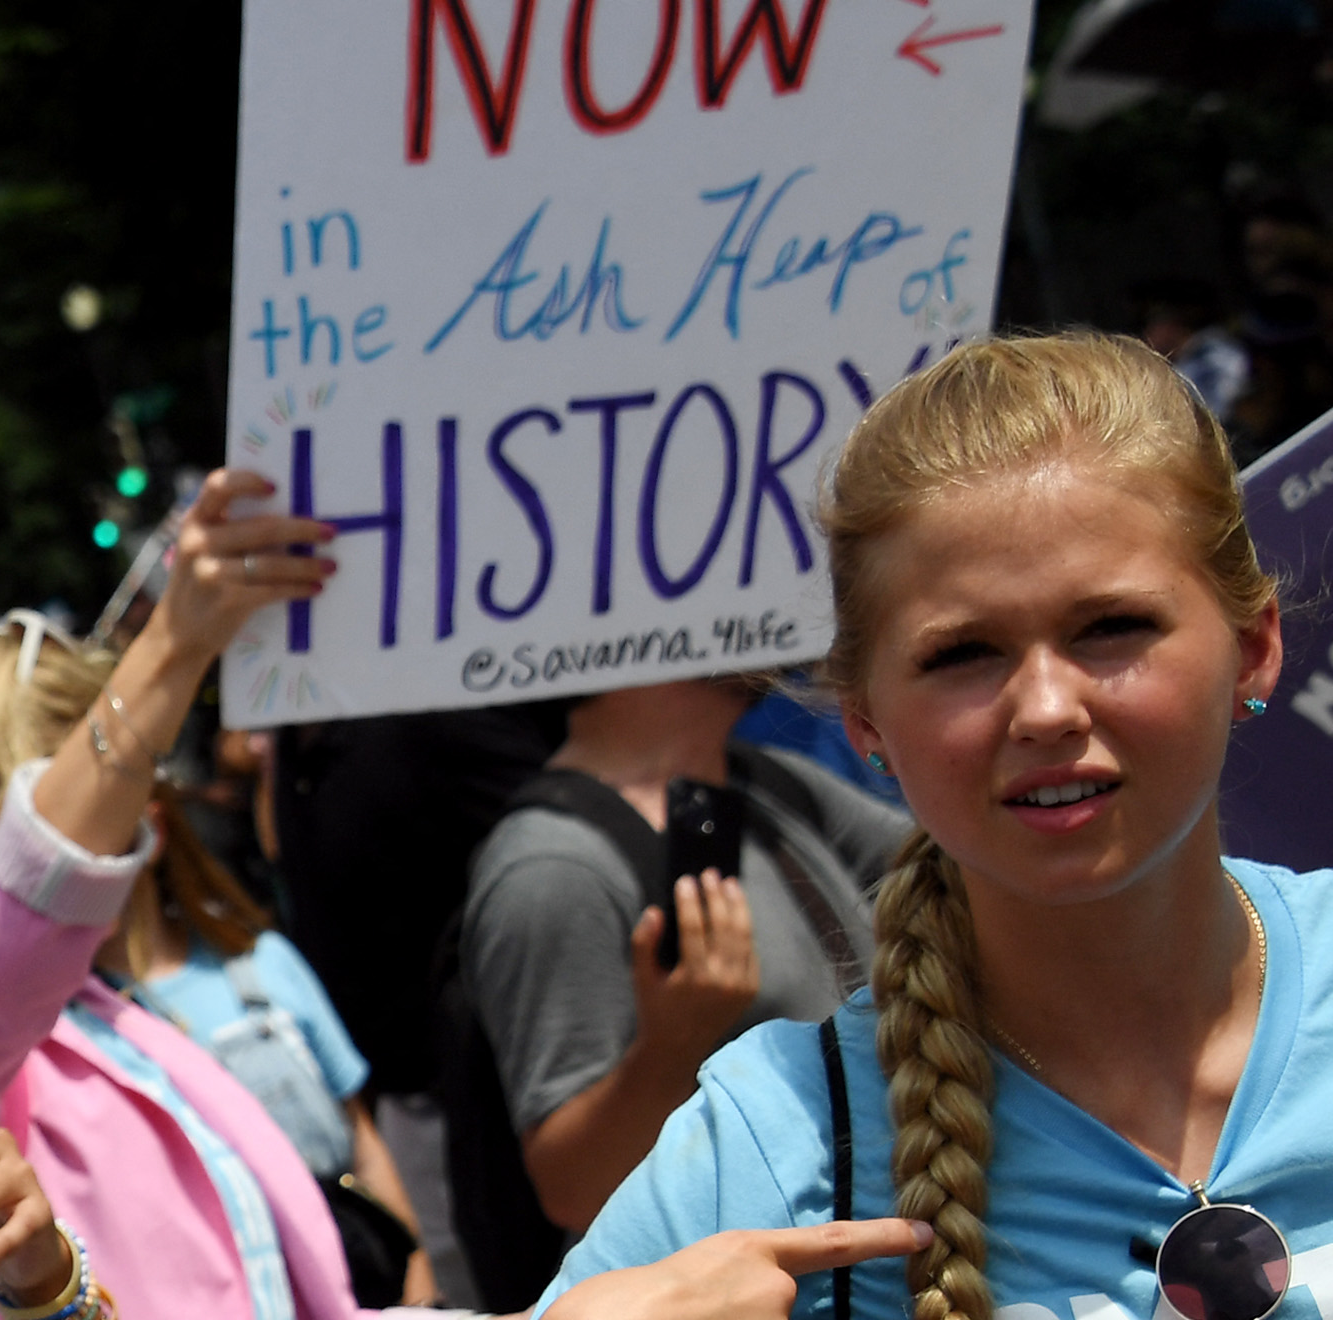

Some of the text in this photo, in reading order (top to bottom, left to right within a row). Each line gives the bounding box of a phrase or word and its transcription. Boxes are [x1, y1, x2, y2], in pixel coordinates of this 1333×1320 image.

[405, 0, 827, 165] NOW
[250, 168, 973, 378] the Ash Heap of
[281, 186, 361, 276] in
